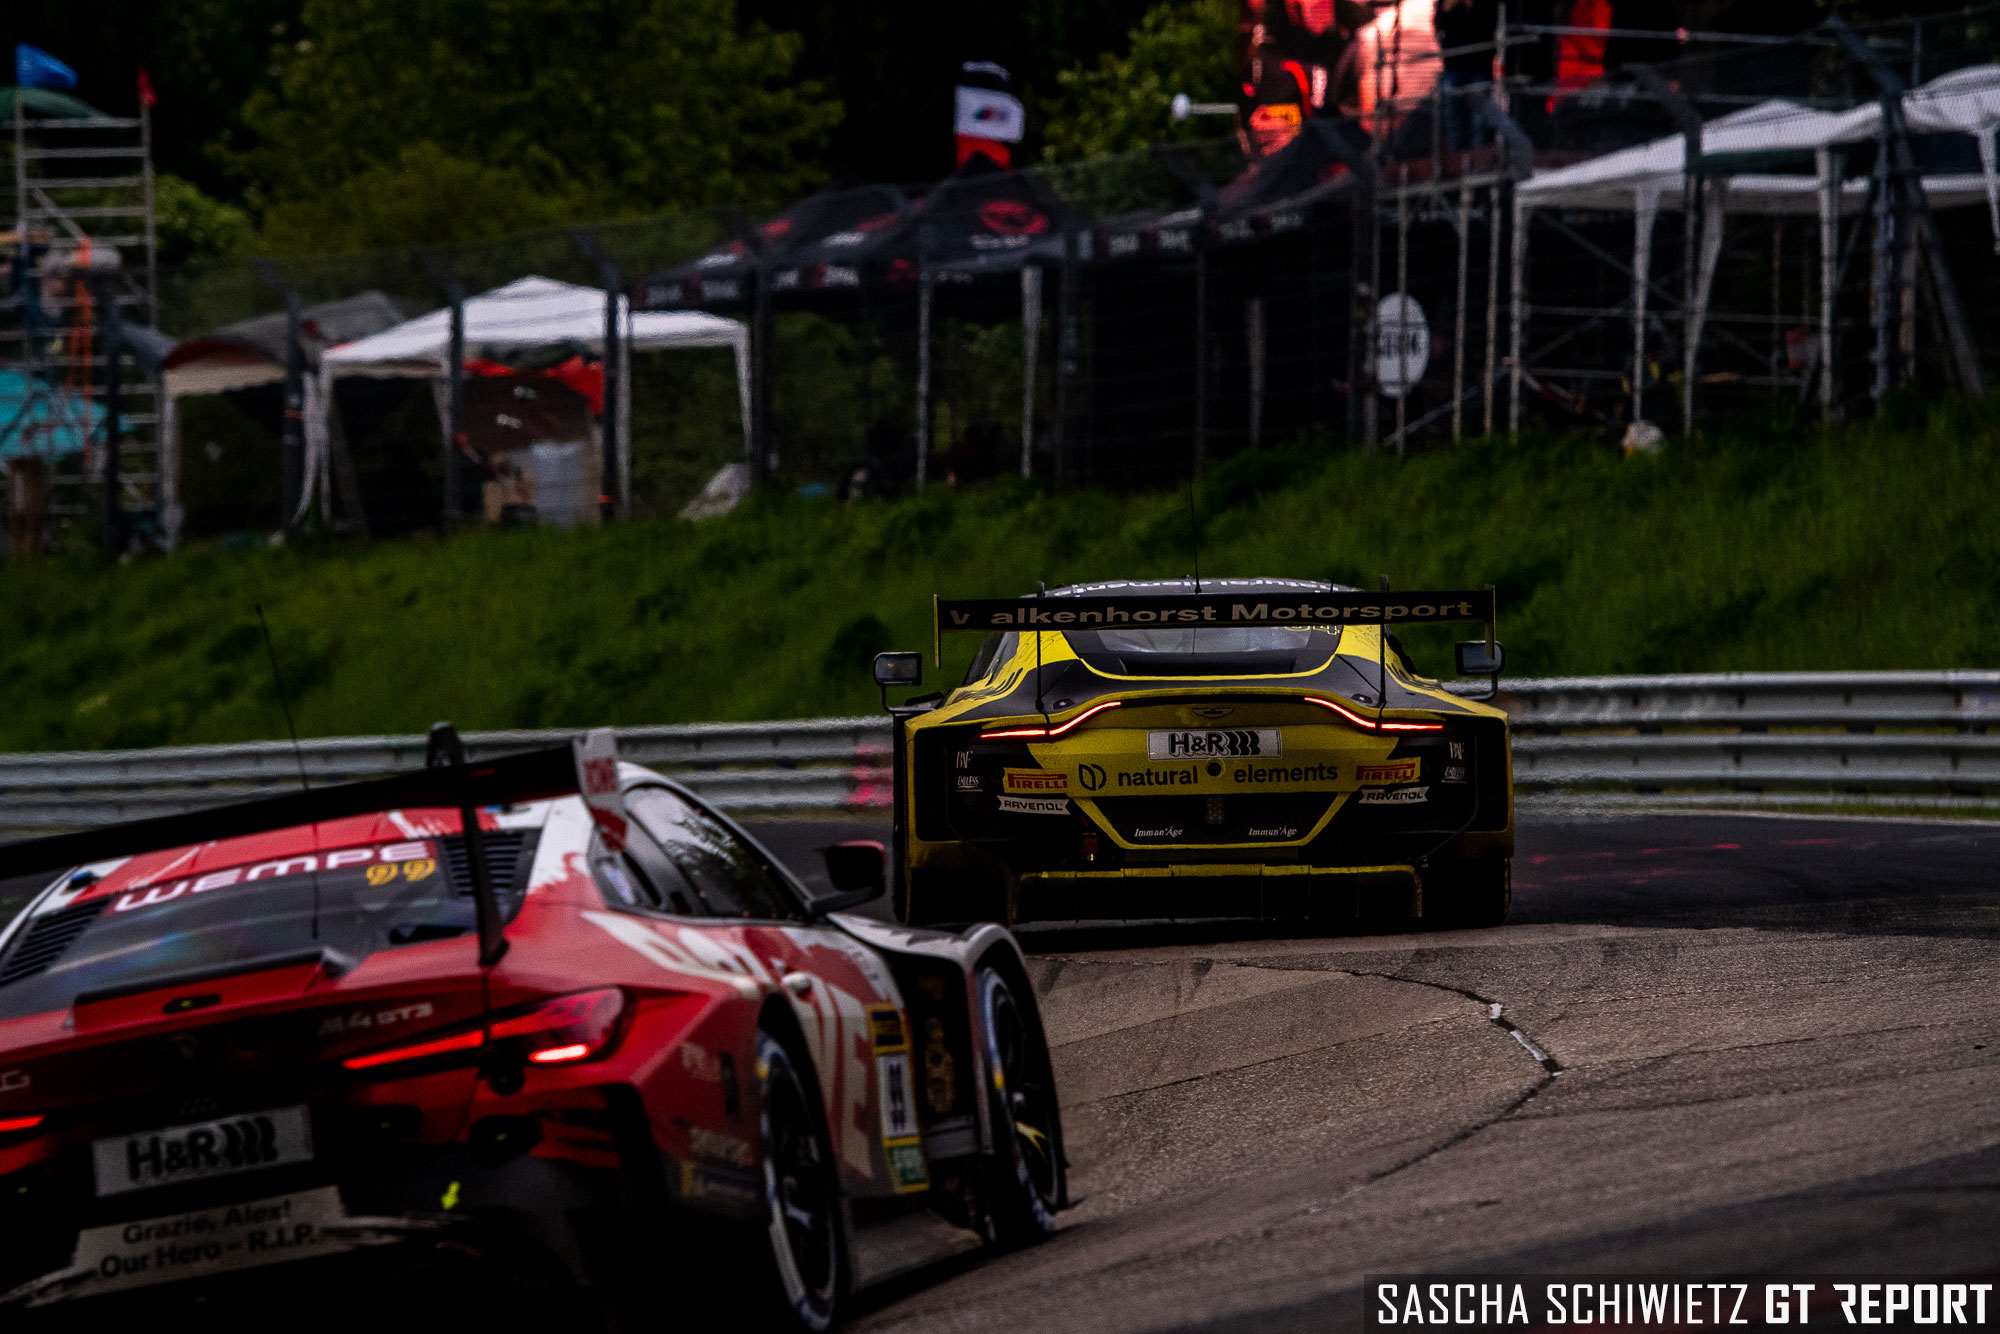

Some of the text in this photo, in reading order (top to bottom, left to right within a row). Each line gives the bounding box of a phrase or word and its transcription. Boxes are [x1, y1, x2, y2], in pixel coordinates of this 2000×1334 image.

[1232, 600, 1473, 621] Motorsport
[1008, 773, 1068, 789] PIRELLI
[1118, 763, 1338, 787] natural elements
[1355, 763, 1416, 781] PIRELLI
[1004, 799, 1063, 811] RAVENOL
[1366, 790, 1423, 801] RAVENOL
[366, 858, 436, 886] 99
[127, 1130, 218, 1181] H&R
[101, 1253, 148, 1277] Our
[156, 1243, 221, 1269] Hero
[248, 1225, 317, 1251] R.I.P.
